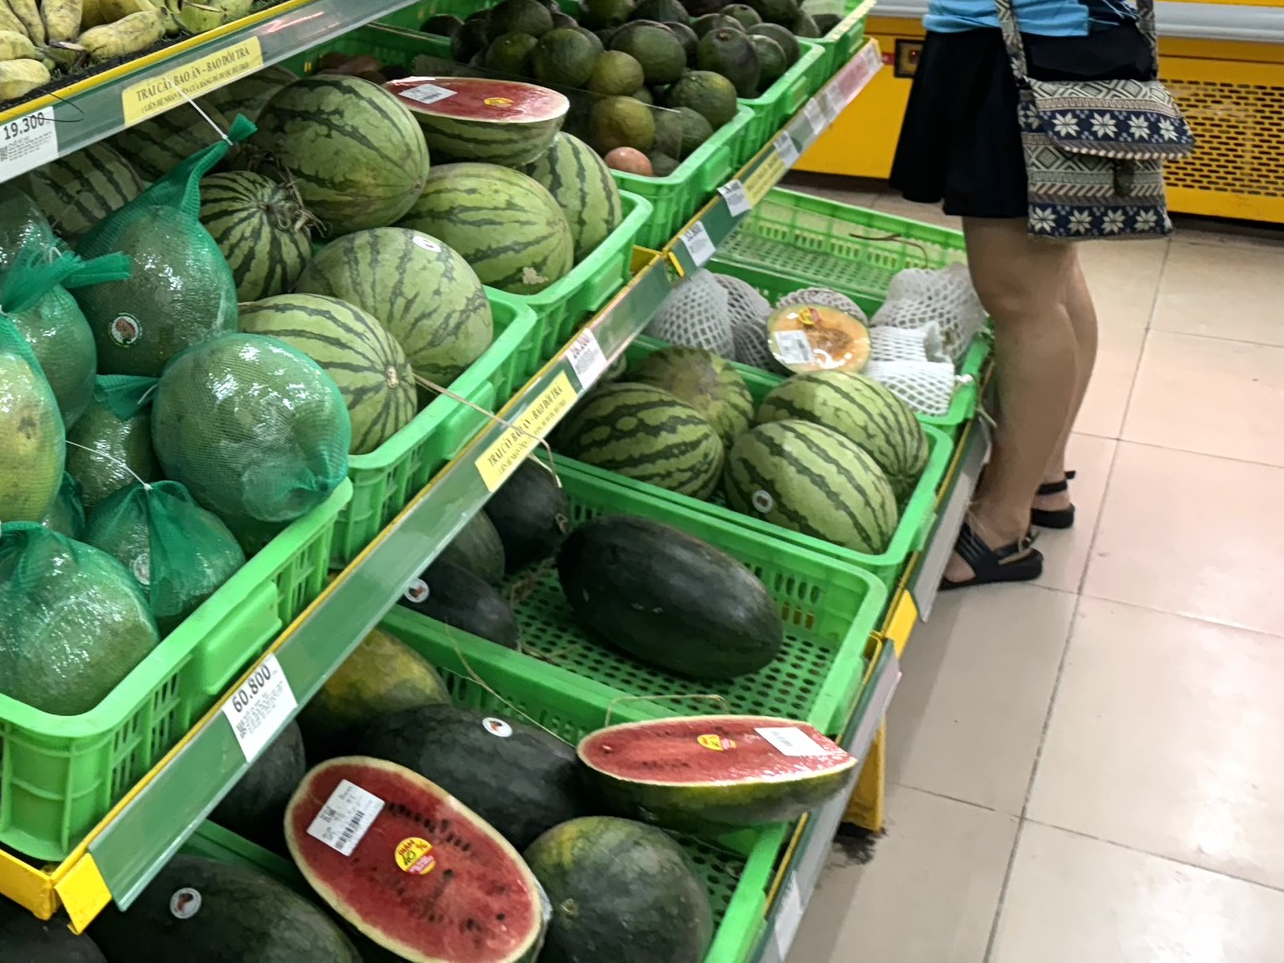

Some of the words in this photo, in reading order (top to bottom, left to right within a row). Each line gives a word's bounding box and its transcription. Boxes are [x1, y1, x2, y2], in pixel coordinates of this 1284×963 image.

[136, 81, 155, 102] TRÁI
[173, 69, 190, 86] BAO
[206, 57, 222, 72] BAO
[3, 112, 45, 140] 19.300
[231, 663, 271, 713] 60.800
